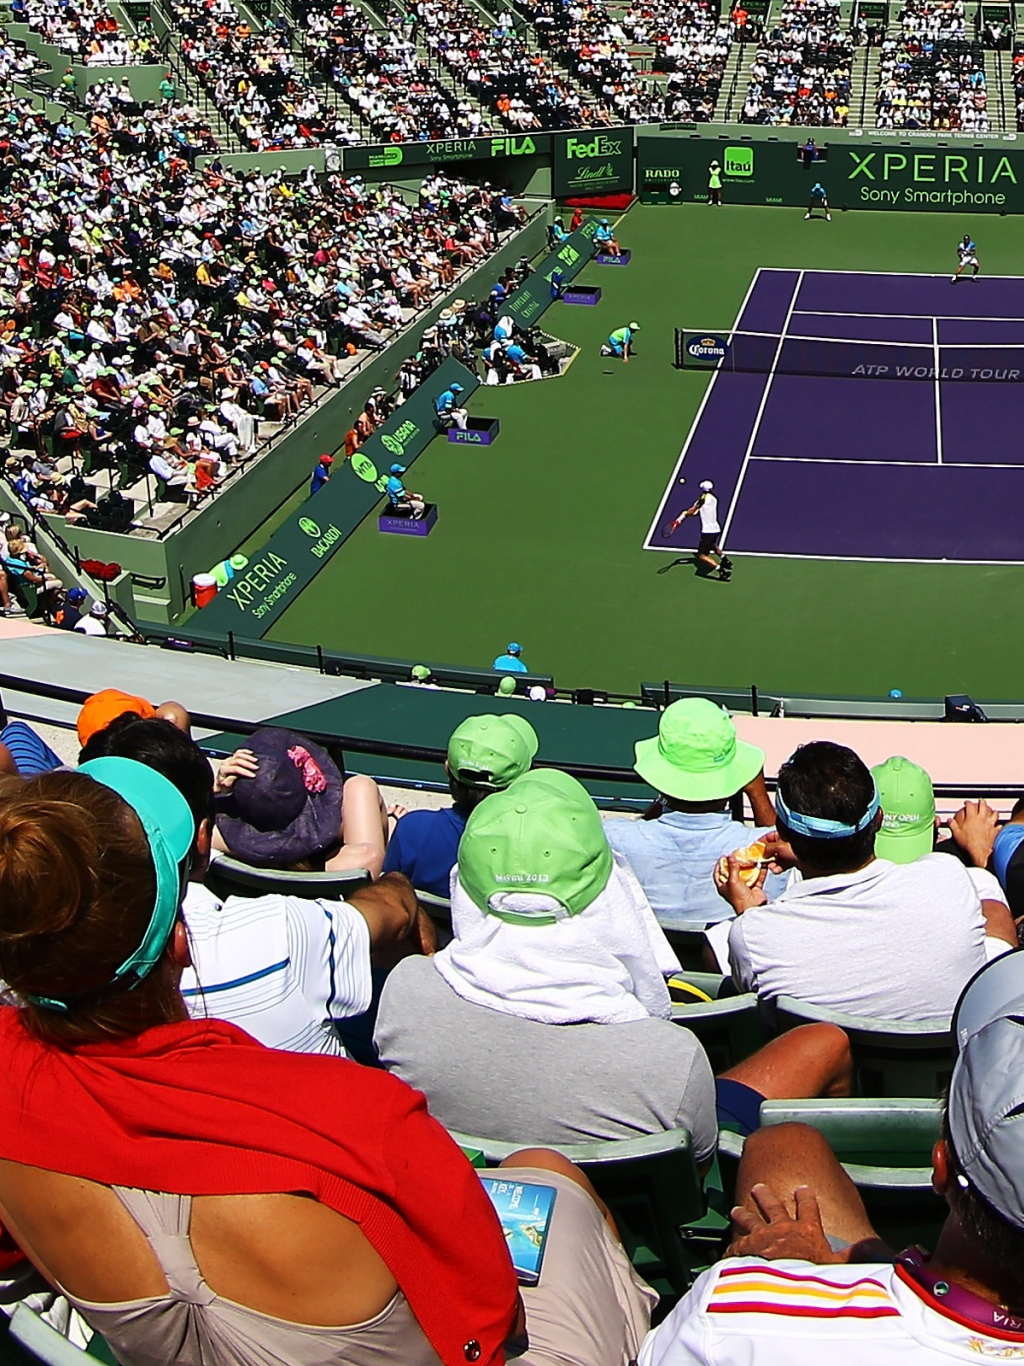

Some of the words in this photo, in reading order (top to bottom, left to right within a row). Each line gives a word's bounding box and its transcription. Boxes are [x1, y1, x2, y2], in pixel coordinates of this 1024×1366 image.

[425, 140, 477, 155] XPERIA
[491, 136, 536, 157] FILA
[566, 136, 622, 160] FedEx
[645, 169, 680, 178] RADO
[726, 160, 751, 172] Itaú
[848, 151, 1018, 184] XPERIA
[860, 186, 900, 204] Sony
[904, 187, 1007, 206] Smartphone
[602, 255, 621, 264] FILA
[689, 344, 725, 356] Corona
[851, 364, 889, 376] ATP
[895, 366, 964, 379] WORLD
[970, 368, 1021, 380] TOUR
[456, 431, 482, 442] FILA
[386, 519, 420, 528] XPERIA
[226, 551, 288, 611] XPERIA
[251, 600, 272, 619] Sony
[264, 571, 298, 607] Smartphone
[898, 813, 920, 821] OPEN
